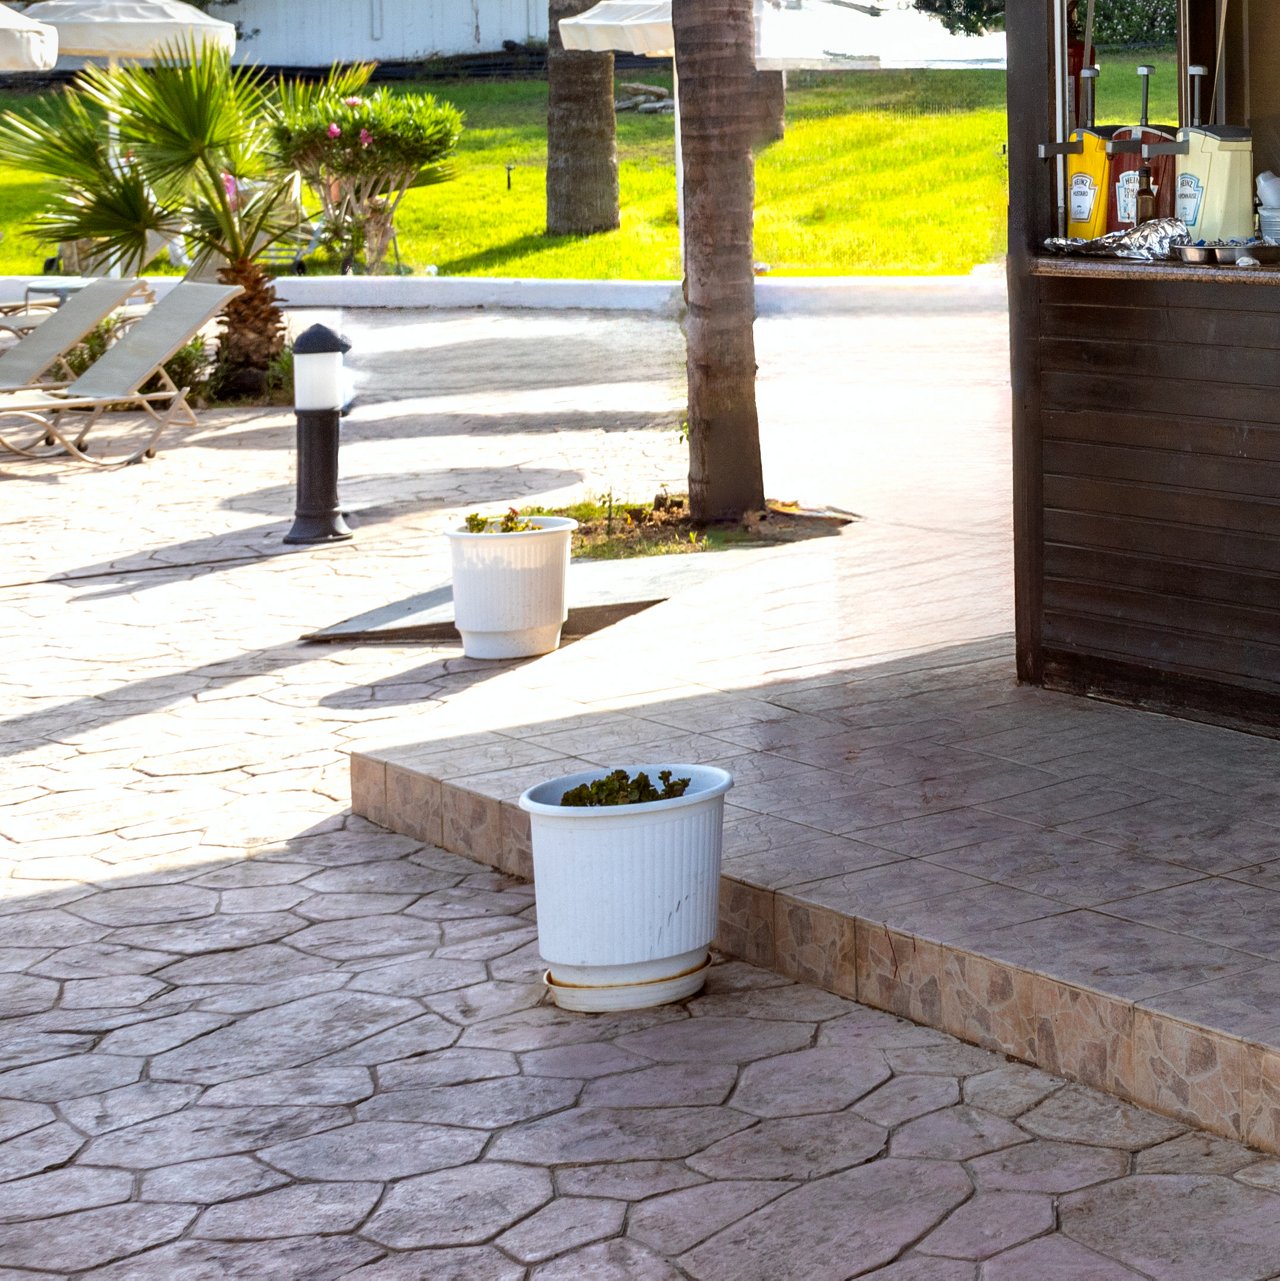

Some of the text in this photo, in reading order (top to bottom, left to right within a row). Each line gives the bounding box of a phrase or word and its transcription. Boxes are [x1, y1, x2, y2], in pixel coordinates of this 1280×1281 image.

[1074, 178, 1088, 186] HEINZ
[1125, 176, 1139, 184] HEIN
[1180, 179, 1193, 188] HEINZ
